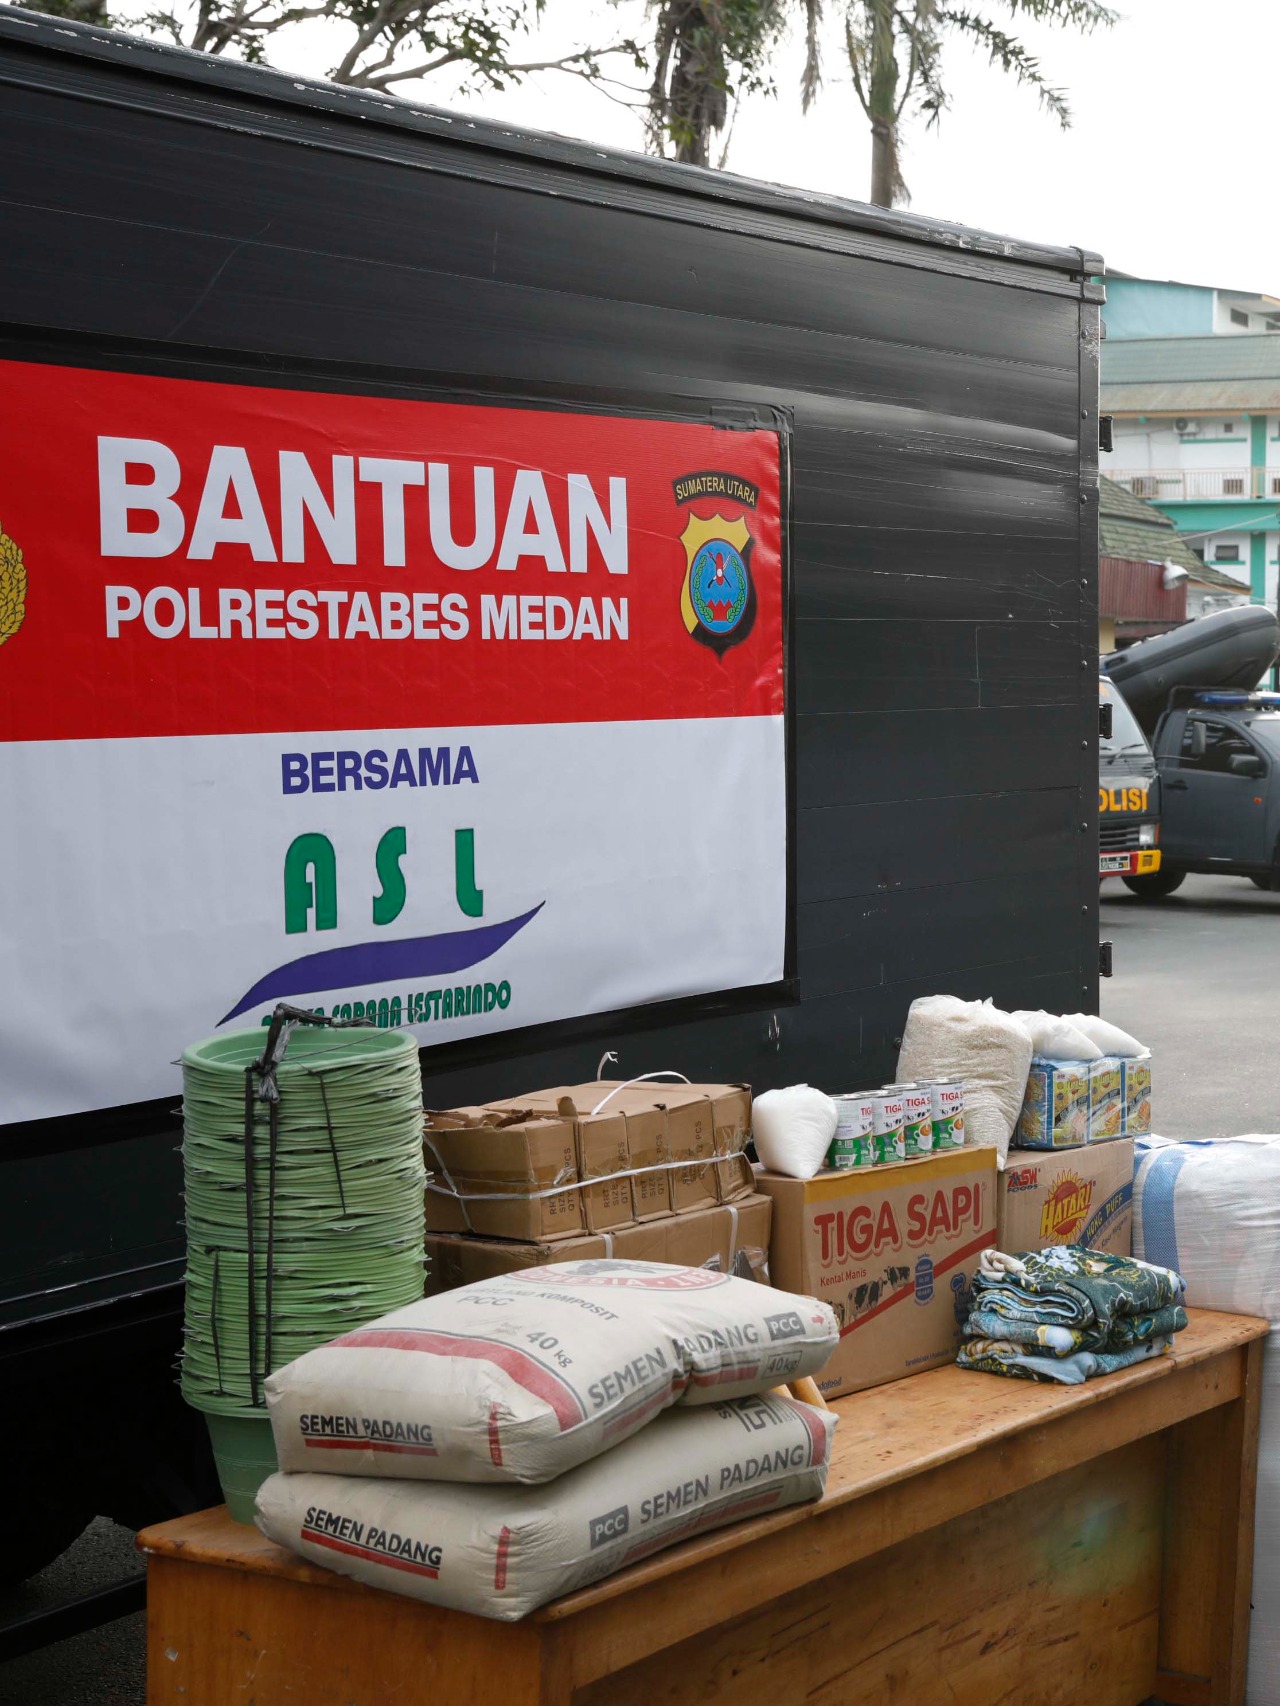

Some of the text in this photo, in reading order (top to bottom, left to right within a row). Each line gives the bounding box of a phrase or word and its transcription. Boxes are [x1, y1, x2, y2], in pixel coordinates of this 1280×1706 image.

[97, 435, 629, 575] BANTUAN
[676, 476, 755, 506] SUMATERA UTARA
[105, 585, 629, 641] POLRESTABES MEDAN
[281, 745, 480, 795] BERSAMA
[1099, 788, 1147, 812] OLISI
[284, 826, 484, 935] ASL
[407, 980, 511, 1024] LESTARINDO
[906, 1097, 926, 1107] TIGA
[941, 1092, 959, 1101] TIGA
[611, 1184, 619, 1206] SIZE
[620, 1185, 628, 1204] QTY
[1007, 1184, 1038, 1193] FOODS
[1040, 1181, 1092, 1239] HATARI
[1106, 1193, 1123, 1217] PUFF
[814, 1182, 981, 1262] TIGA SAPI
[820, 1269, 867, 1287] Kental Manis
[456, 1295, 515, 1306] PCC
[536, 1292, 620, 1321] KOMPOSIT
[769, 1316, 801, 1336] PCC
[526, 1332, 574, 1368] 40 kg
[587, 1346, 668, 1409] SEMEN
[300, 1414, 433, 1442] SEMEN PADANG
[594, 1445, 804, 1541] PCC SEMEN PADANG
[304, 1507, 443, 1566] SEMEN PADANG
